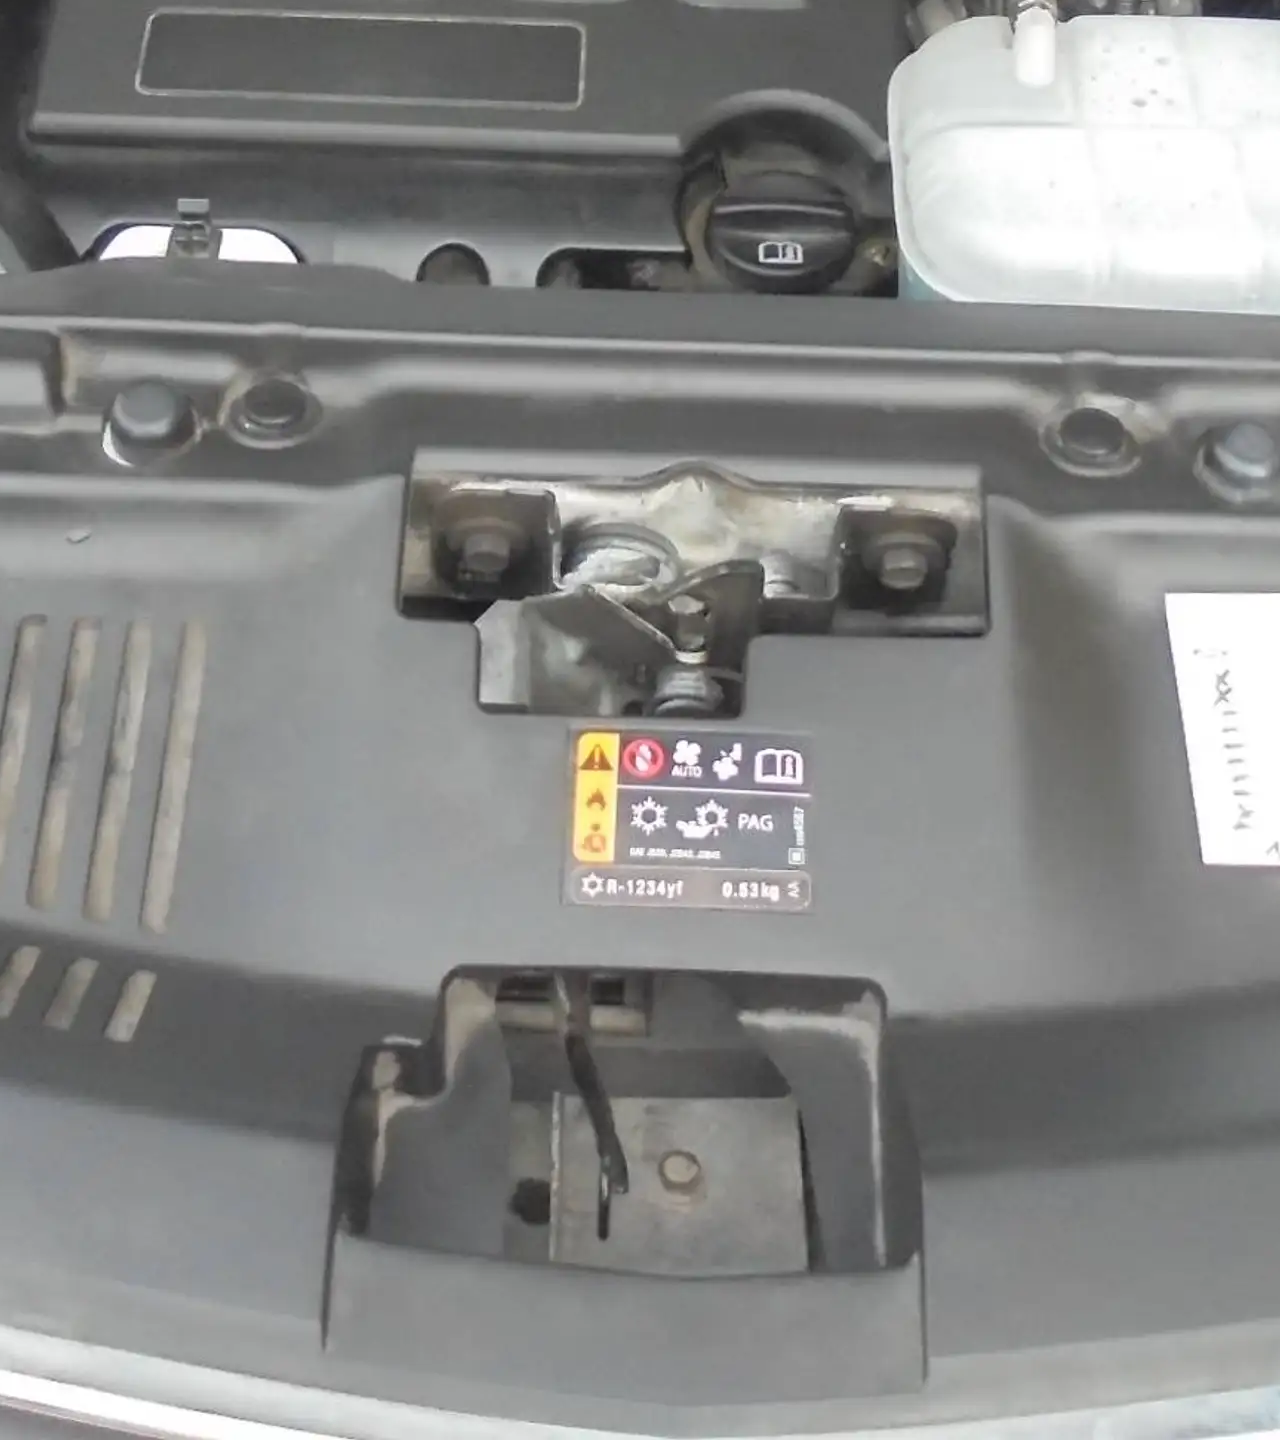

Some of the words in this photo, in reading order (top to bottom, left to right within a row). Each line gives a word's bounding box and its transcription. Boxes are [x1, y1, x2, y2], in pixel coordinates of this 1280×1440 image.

[671, 764, 702, 778] AUTO
[737, 813, 773, 832] PAG
[606, 878, 684, 899] R-1234yf
